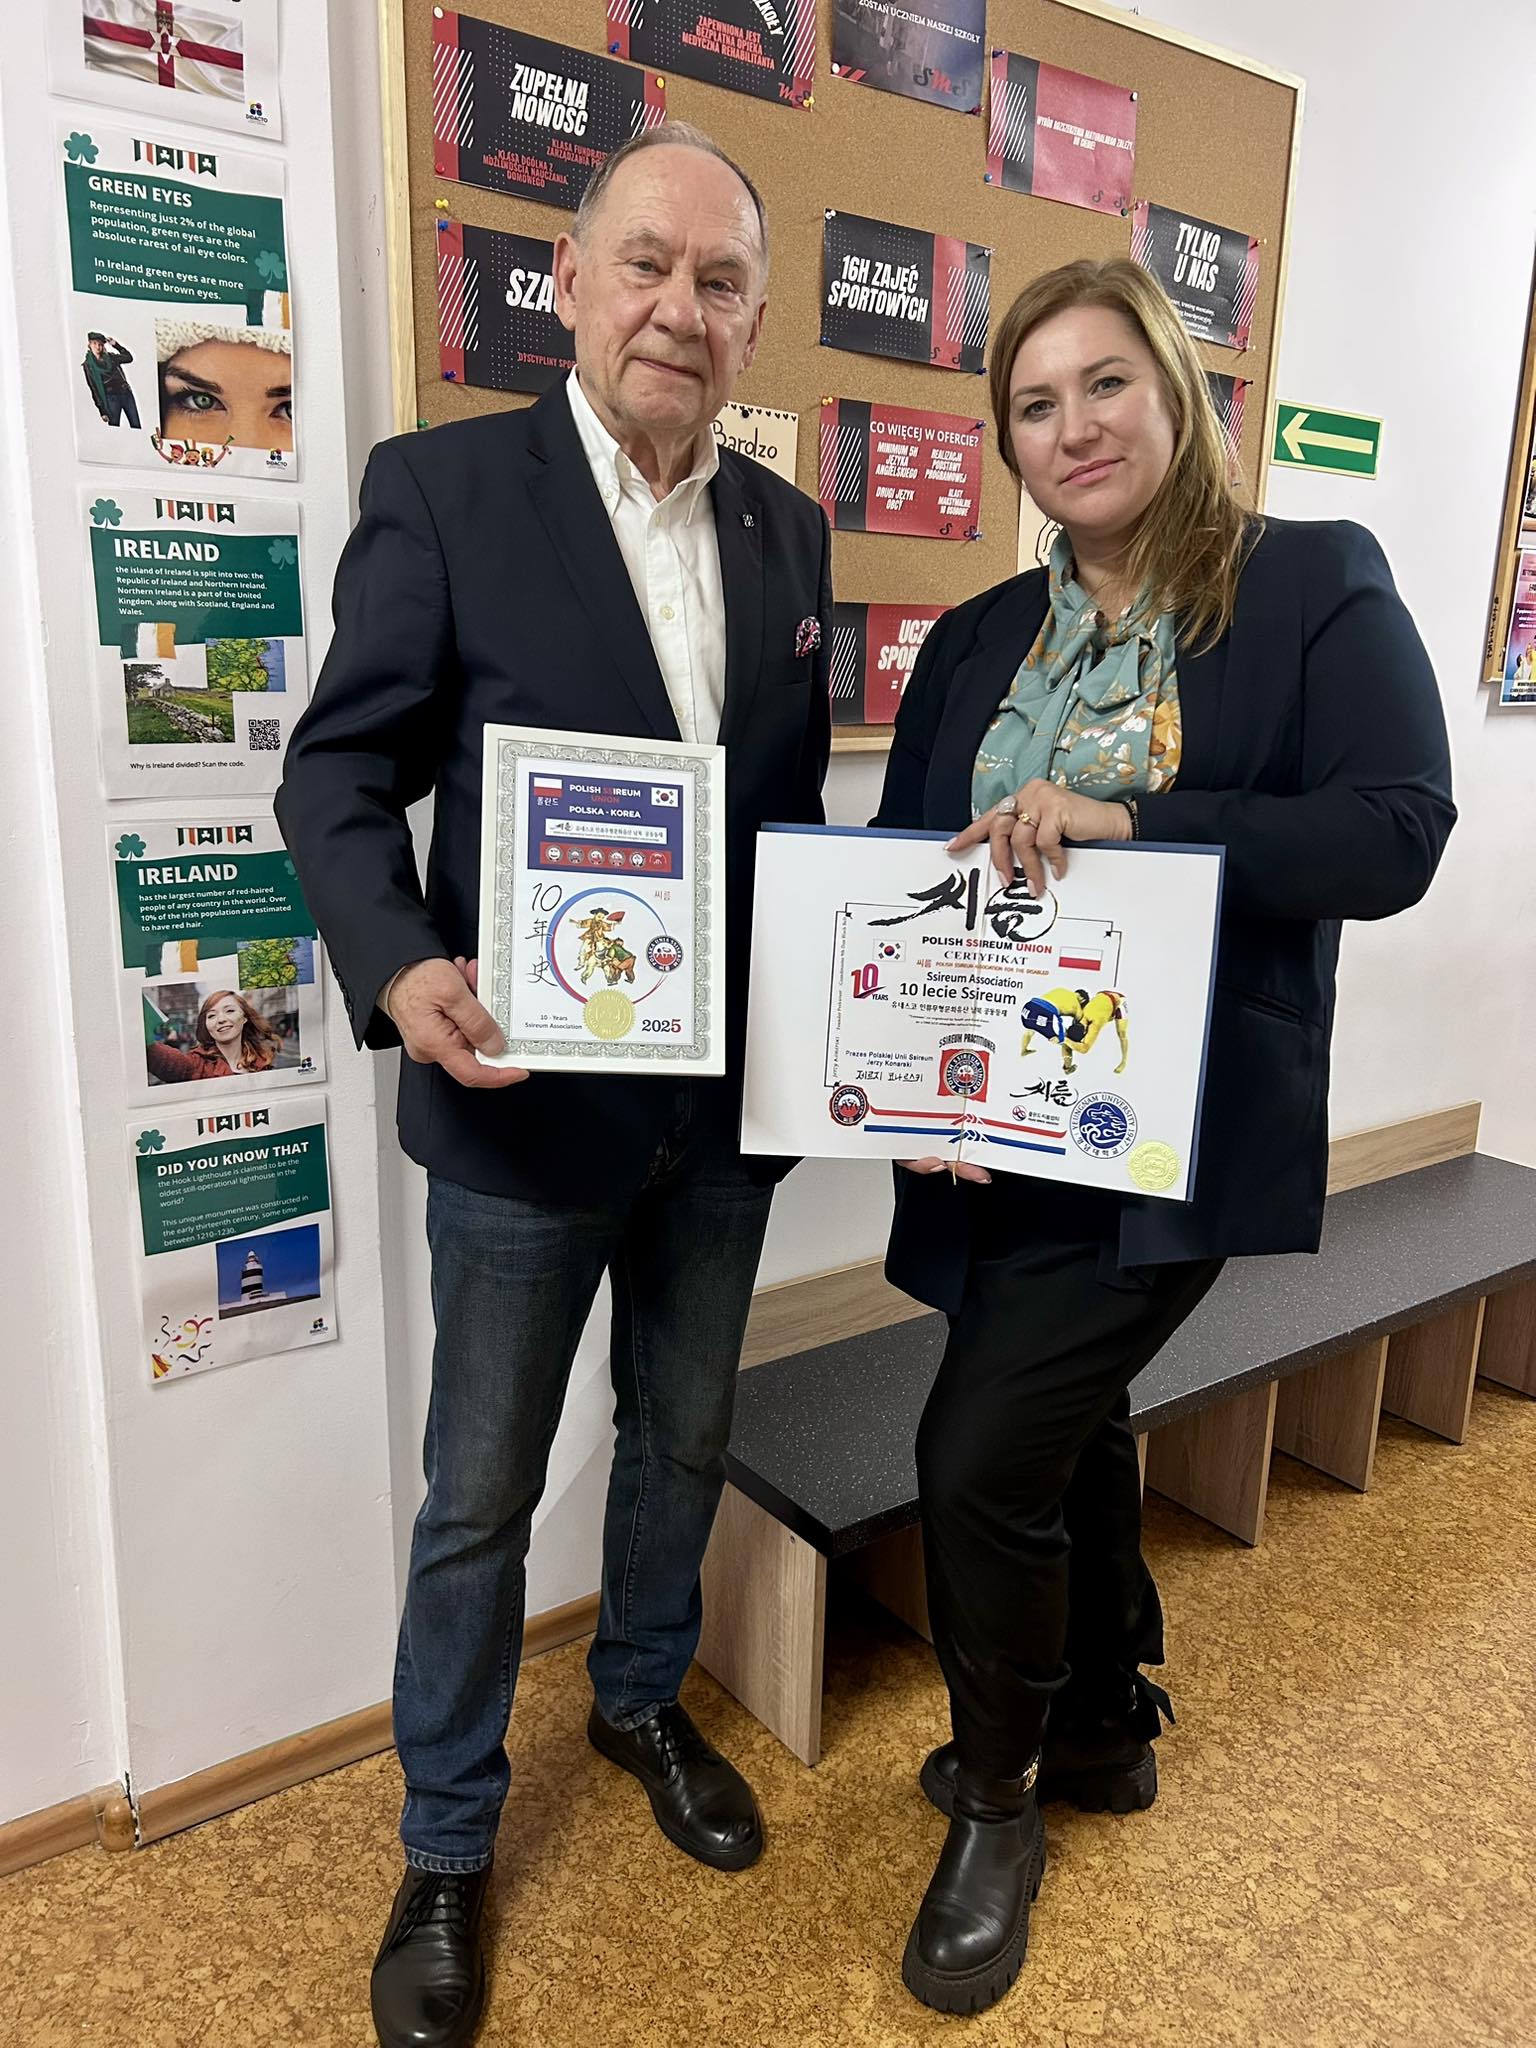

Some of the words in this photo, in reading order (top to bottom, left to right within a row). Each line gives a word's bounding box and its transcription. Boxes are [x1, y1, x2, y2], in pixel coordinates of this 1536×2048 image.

[699, 15, 743, 38] ZAPEWNIONA
[745, 29, 761, 44] JEST
[890, 7, 926, 26] UCZNIEM
[926, 19, 953, 34] NASZEJ
[954, 29, 980, 44] SZKOŁY
[696, 25, 735, 45] BEZPŁATNA
[737, 37, 762, 55] OPIEKA
[682, 32, 720, 53] MEDYCZNA
[721, 44, 775, 70] REHABILITANTA
[246, 114, 268, 123] DIDACTO
[552, 139, 572, 151] KLASA
[498, 150, 519, 163] KLASA
[507, 169, 545, 188] DOMOWEGO
[531, 167, 568, 184] NAUCZANIA
[88, 176, 146, 200] GREEN
[152, 188, 192, 208] EYES
[90, 200, 157, 223] Representing
[158, 212, 178, 224] just
[180, 217, 194, 228] 2%
[197, 221, 208, 229] of
[209, 223, 225, 233] the
[227, 225, 256, 238] global
[91, 216, 150, 234] population,
[151, 227, 179, 238] green
[182, 233, 204, 243] eyes
[206, 237, 223, 246] are
[224, 238, 241, 249] the
[92, 229, 137, 244] absolute
[139, 238, 169, 250] rarest
[171, 243, 182, 252] of
[183, 246, 195, 254] all
[197, 249, 214, 259] eye
[217, 250, 248, 264] colors.
[1175, 222, 1221, 263] TYLKO
[94, 258, 105, 267] In
[107, 259, 144, 274] Ireland
[146, 266, 174, 278] green
[176, 272, 198, 282] eyes
[200, 276, 217, 286] are
[219, 279, 244, 290] more
[842, 254, 870, 284] 16H
[871, 261, 919, 295] ZAJĘĆ
[1173, 253, 1189, 282] U
[1186, 258, 1219, 293] NAS
[95, 273, 135, 287] popular
[137, 279, 161, 290] than
[163, 283, 195, 296] brown
[197, 290, 221, 300] eyes.
[505, 268, 557, 314] SZA
[828, 280, 929, 323] SPORTOWYCH
[517, 352, 557, 365] DYSCYPLINY
[713, 420, 777, 459] Bardzo
[870, 421, 885, 433] CO
[887, 423, 922, 441] WIĘCEJ
[925, 428, 935, 440] W
[937, 431, 979, 447] OFERCIE?
[877, 442, 909, 456] MINIMUM
[909, 446, 919, 457] 5H
[931, 449, 962, 461] REALIZACJA
[886, 454, 909, 467] JĘZYKA
[932, 460, 962, 472] PODSTAWY
[875, 464, 918, 479] ANGIELSKIEGO
[925, 469, 967, 483] PROGRAMOWEJ
[876, 486, 895, 498] DRUGI
[895, 489, 915, 501] JĘZYK
[886, 499, 904, 511] OBCY
[114, 538, 220, 562] IRELAND
[877, 645, 921, 670] SPOR
[569, 784, 601, 794] POLISH
[602, 787, 640, 797] SSIREUM
[592, 796, 620, 804] UNION
[569, 806, 604, 816] POLSKA
[611, 808, 641, 818] KOREA
[138, 864, 238, 886] IRELAND
[169, 892, 195, 901] largest
[196, 890, 225, 898] number
[236, 887, 274, 895] red-haired
[654, 890, 671, 901] 씨름
[140, 905, 165, 913] people
[192, 900, 221, 908] country
[922, 936, 963, 947] POLISH
[965, 938, 1013, 950] SSIREUM
[1016, 943, 1052, 954] UNION
[944, 950, 1028, 965] CERTYFIKAT
[851, 963, 879, 999] 10
[927, 972, 967, 983] Ssireum
[969, 974, 1023, 989] Association
[900, 983, 918, 996] 10
[923, 983, 957, 998] lecie
[961, 986, 1016, 1004] Ssireum
[892, 1001, 917, 1010] 유네스코
[642, 1019, 682, 1033] 2025
[939, 1033, 962, 1048] SSIREUM
[964, 1033, 996, 1055] PRACTITIONER
[846, 1050, 867, 1058] Prezes
[869, 1052, 893, 1060] Polskiej
[909, 1054, 934, 1062] Ssireum
[866, 1059, 883, 1067] Jerzy
[885, 1060, 912, 1068] Konarski
[1009, 1077, 1078, 1107] 씨름
[1072, 1095, 1098, 1130] YEUNGNAM
[1102, 1095, 1135, 1126] UNIVERSITY
[1124, 1129, 1134, 1146] 1947
[157, 1163, 183, 1177] DID
[187, 1156, 218, 1171] YOU
[223, 1148, 269, 1165] KNOW
[272, 1142, 309, 1157] THAT
